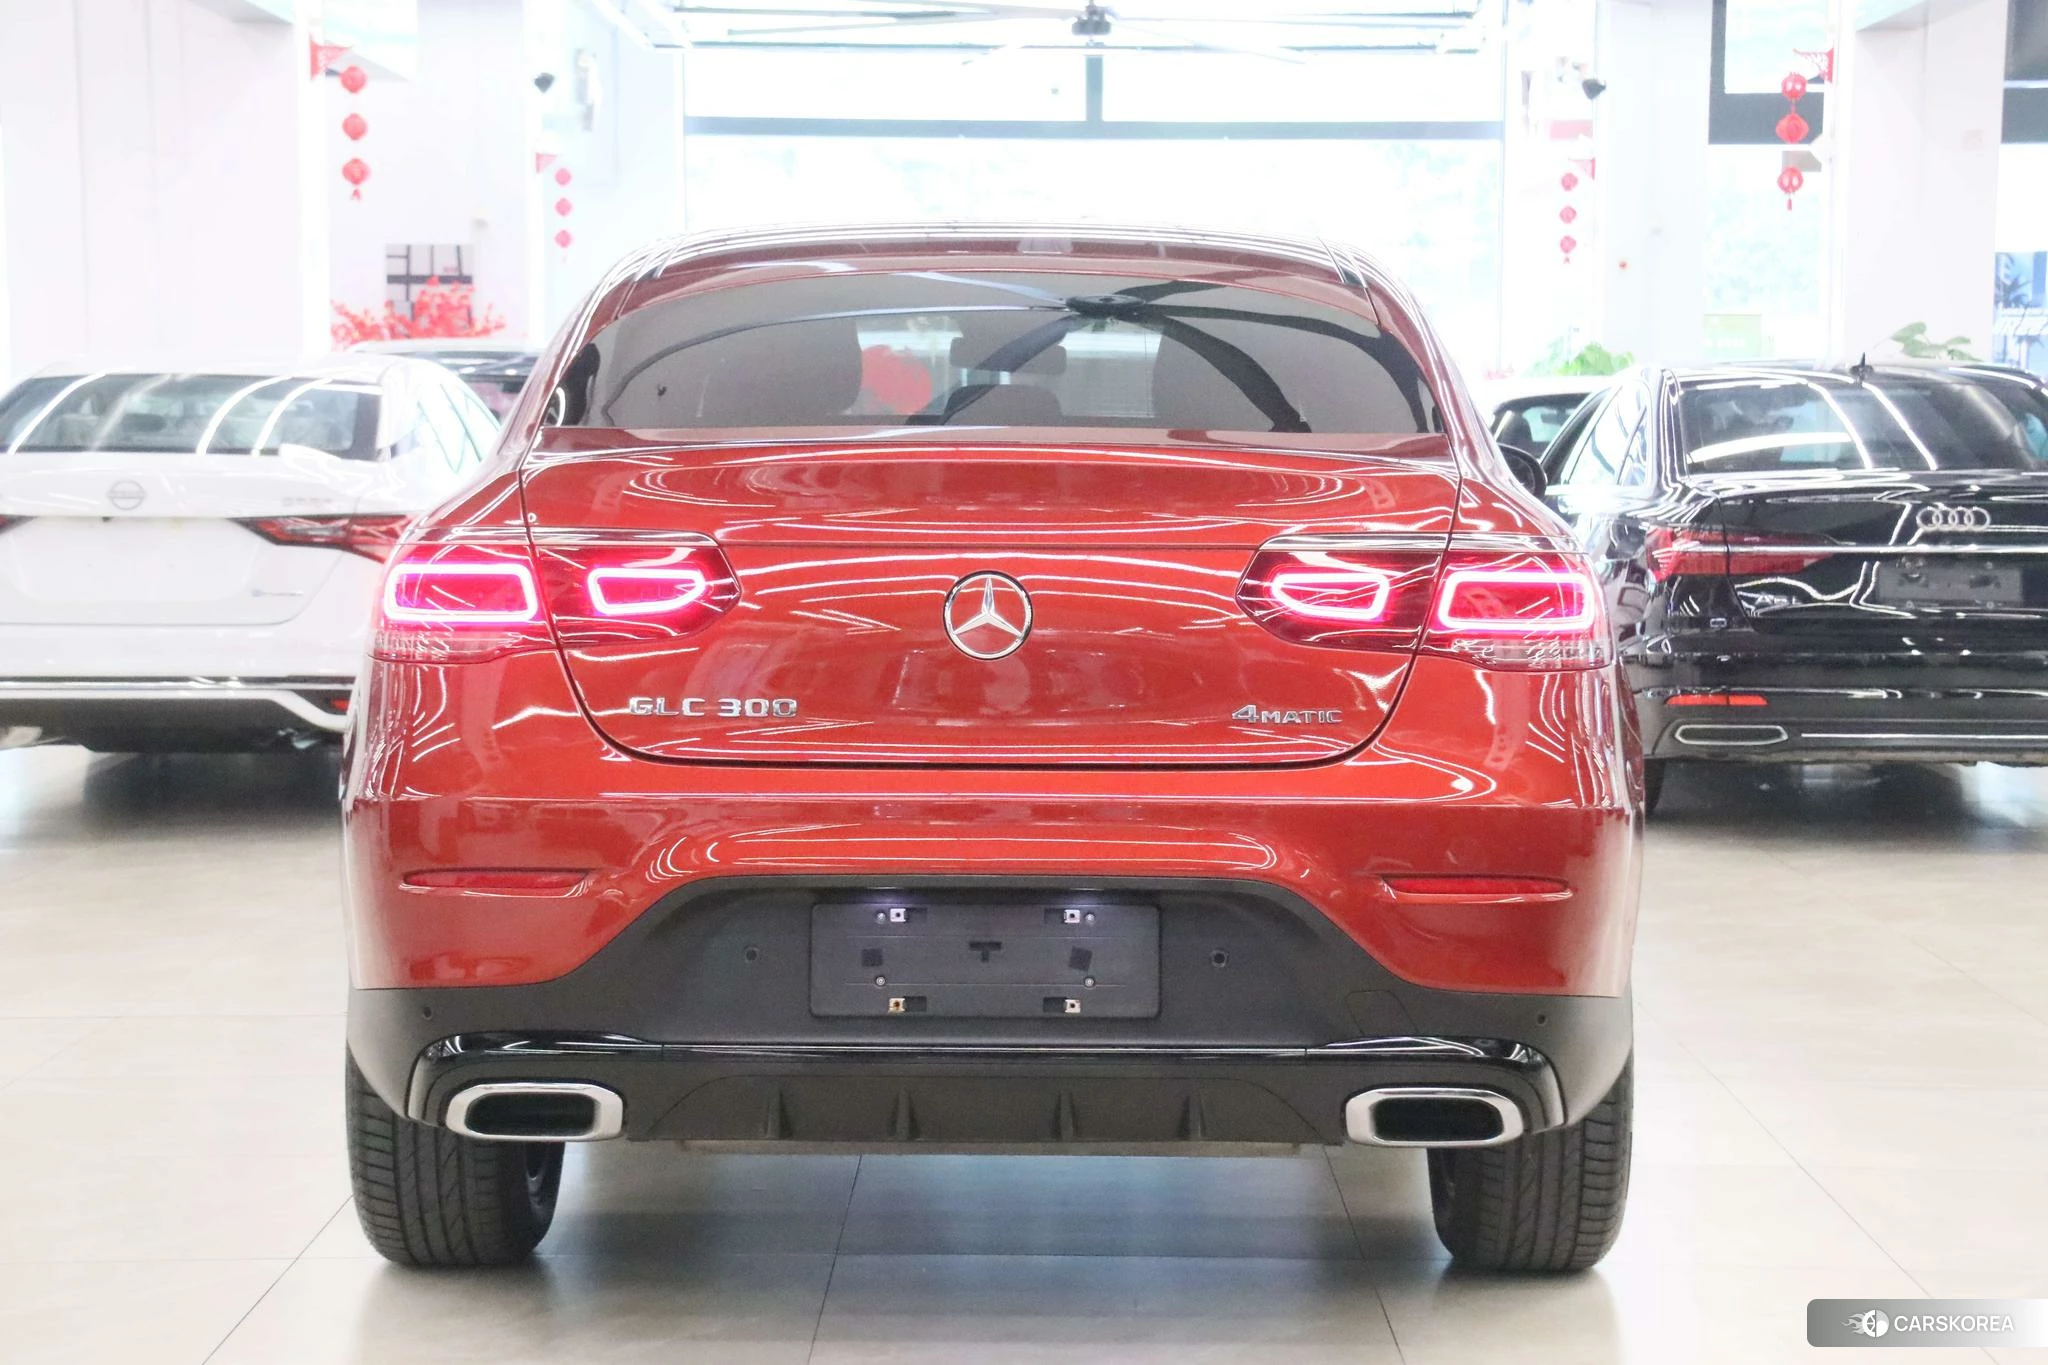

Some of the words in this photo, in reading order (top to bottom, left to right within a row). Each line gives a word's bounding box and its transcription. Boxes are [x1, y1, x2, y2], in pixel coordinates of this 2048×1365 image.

[628, 696, 706, 717] GLC
[717, 698, 798, 718] 300
[1232, 704, 1343, 724] 4MATIC
